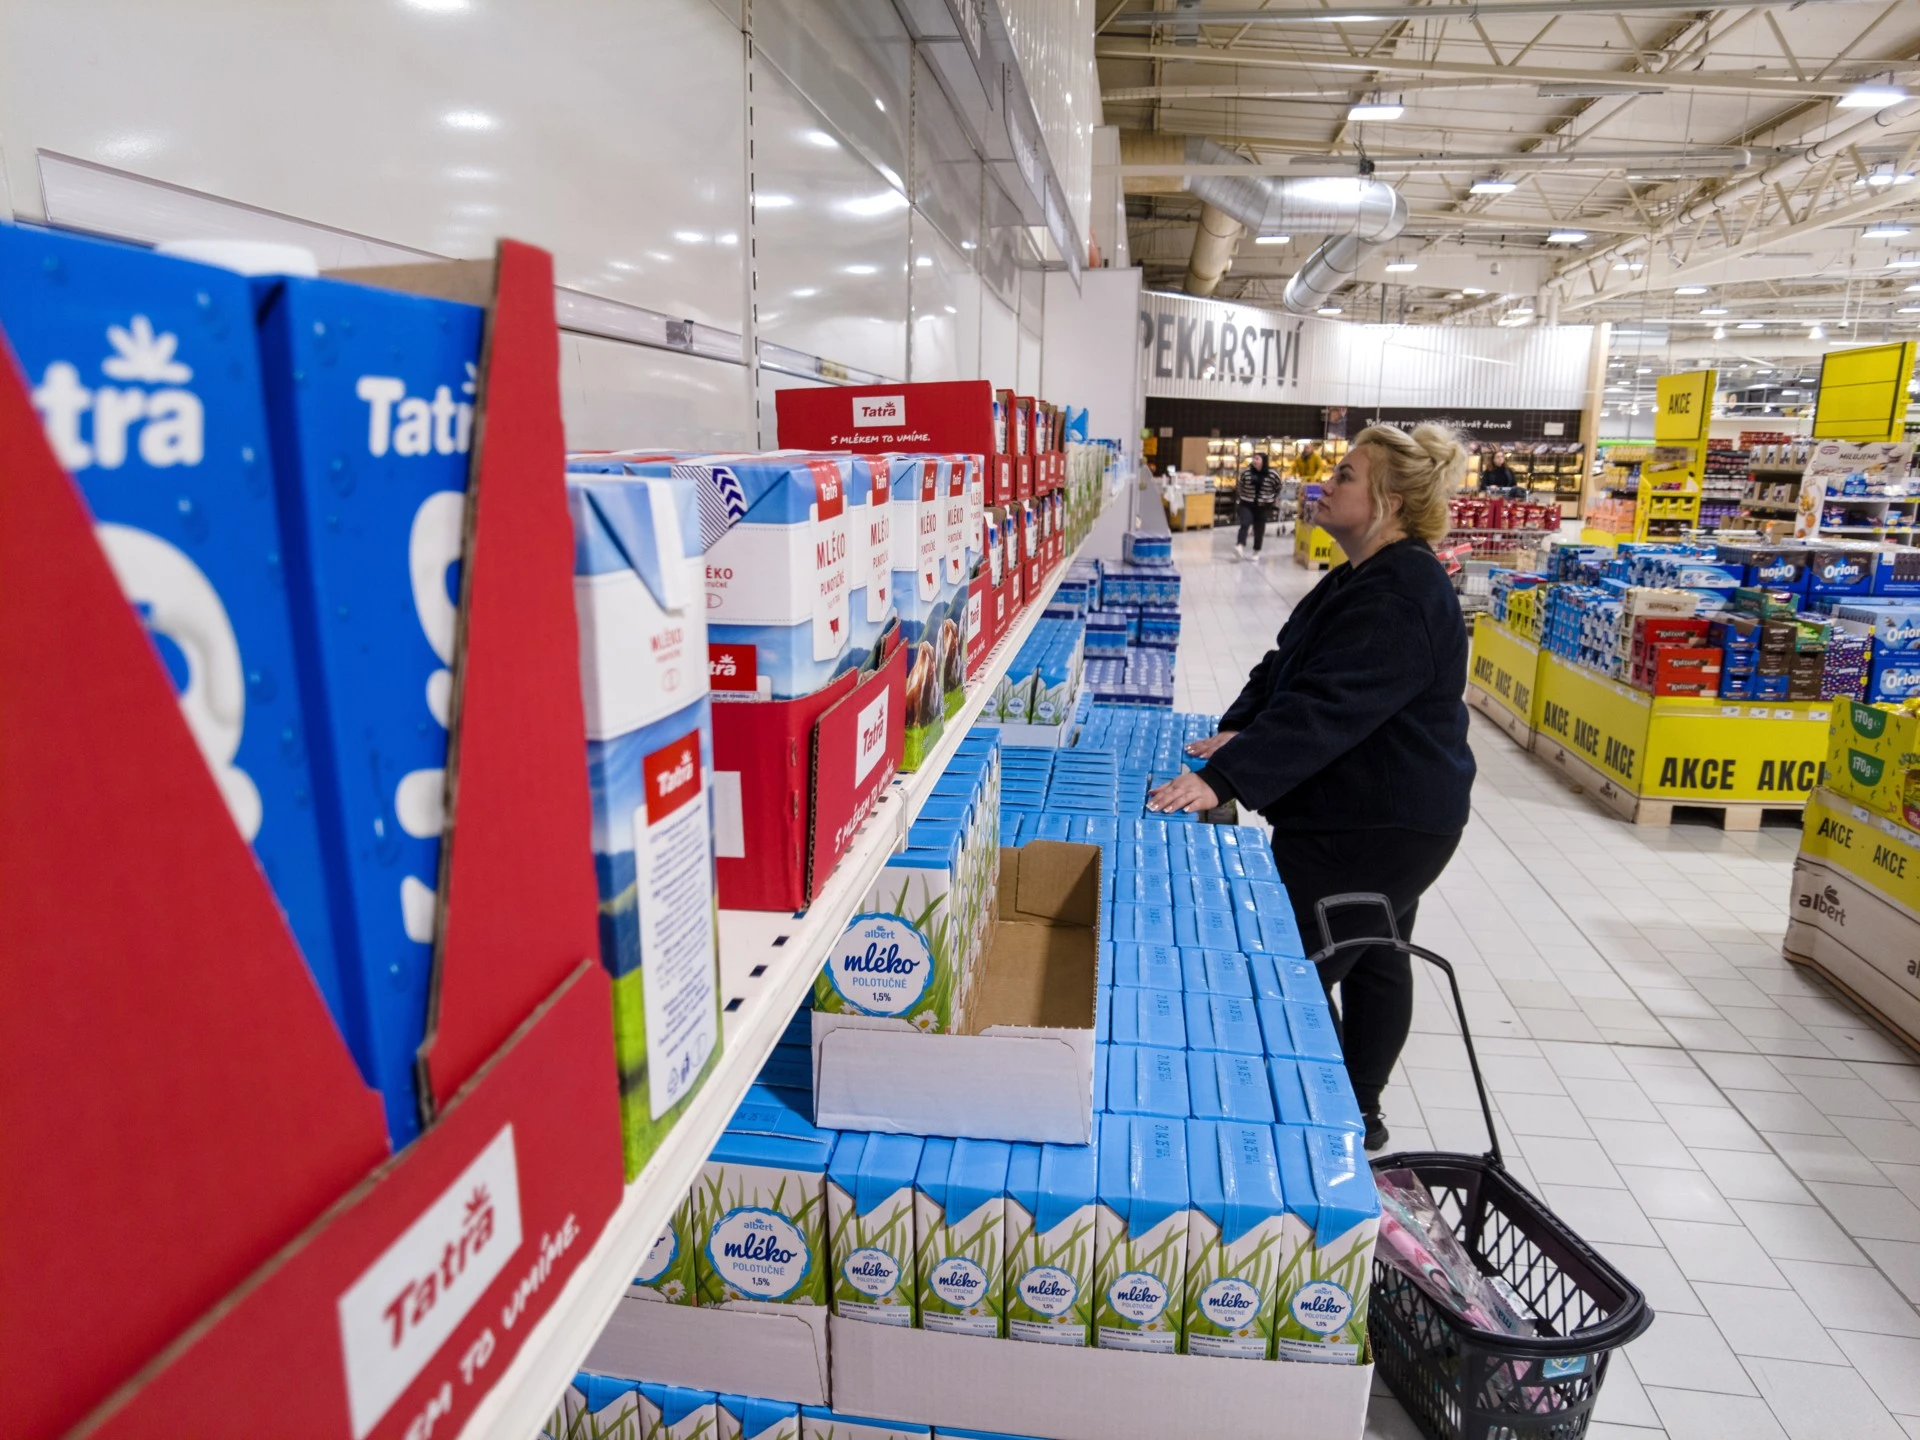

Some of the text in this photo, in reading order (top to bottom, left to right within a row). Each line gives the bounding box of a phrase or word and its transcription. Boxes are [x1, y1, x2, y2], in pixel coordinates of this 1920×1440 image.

[861, 402, 897, 418] Tatra
[1668, 392, 1692, 414] AKCE
[839, 433, 880, 444] MLÉKEM
[882, 433, 895, 443] TO
[896, 431, 931, 443] UMÍME.
[1823, 563, 1859, 579] Orion
[1474, 655, 1531, 715] AKCE AKCE AKCE
[1854, 708, 1874, 731] 170g
[862, 718, 884, 757] Tatra
[1543, 699, 1636, 780] AKCE AKCE AKCE
[1659, 757, 1737, 791] AKCE
[1817, 816, 1908, 880] AKCE AKCE
[1798, 890, 1848, 928] albert
[864, 929, 896, 940] albert
[843, 941, 921, 975] mléko
[852, 976, 908, 989] POLOTUČNÉ
[872, 992, 892, 1002] 1,5%
[743, 1221, 774, 1232] albert
[724, 1233, 797, 1264] mléko
[732, 1261, 786, 1276] POLOTUČNÉ
[852, 1261, 893, 1278] mléko
[751, 1276, 770, 1288] 1,5%
[938, 1271, 982, 1289] mléko
[1026, 1279, 1071, 1297] mléko
[1116, 1286, 1161, 1303] mléko
[1208, 1292, 1253, 1310] mléko
[1300, 1296, 1346, 1315] mléko
[458, 1327, 496, 1385] TO
